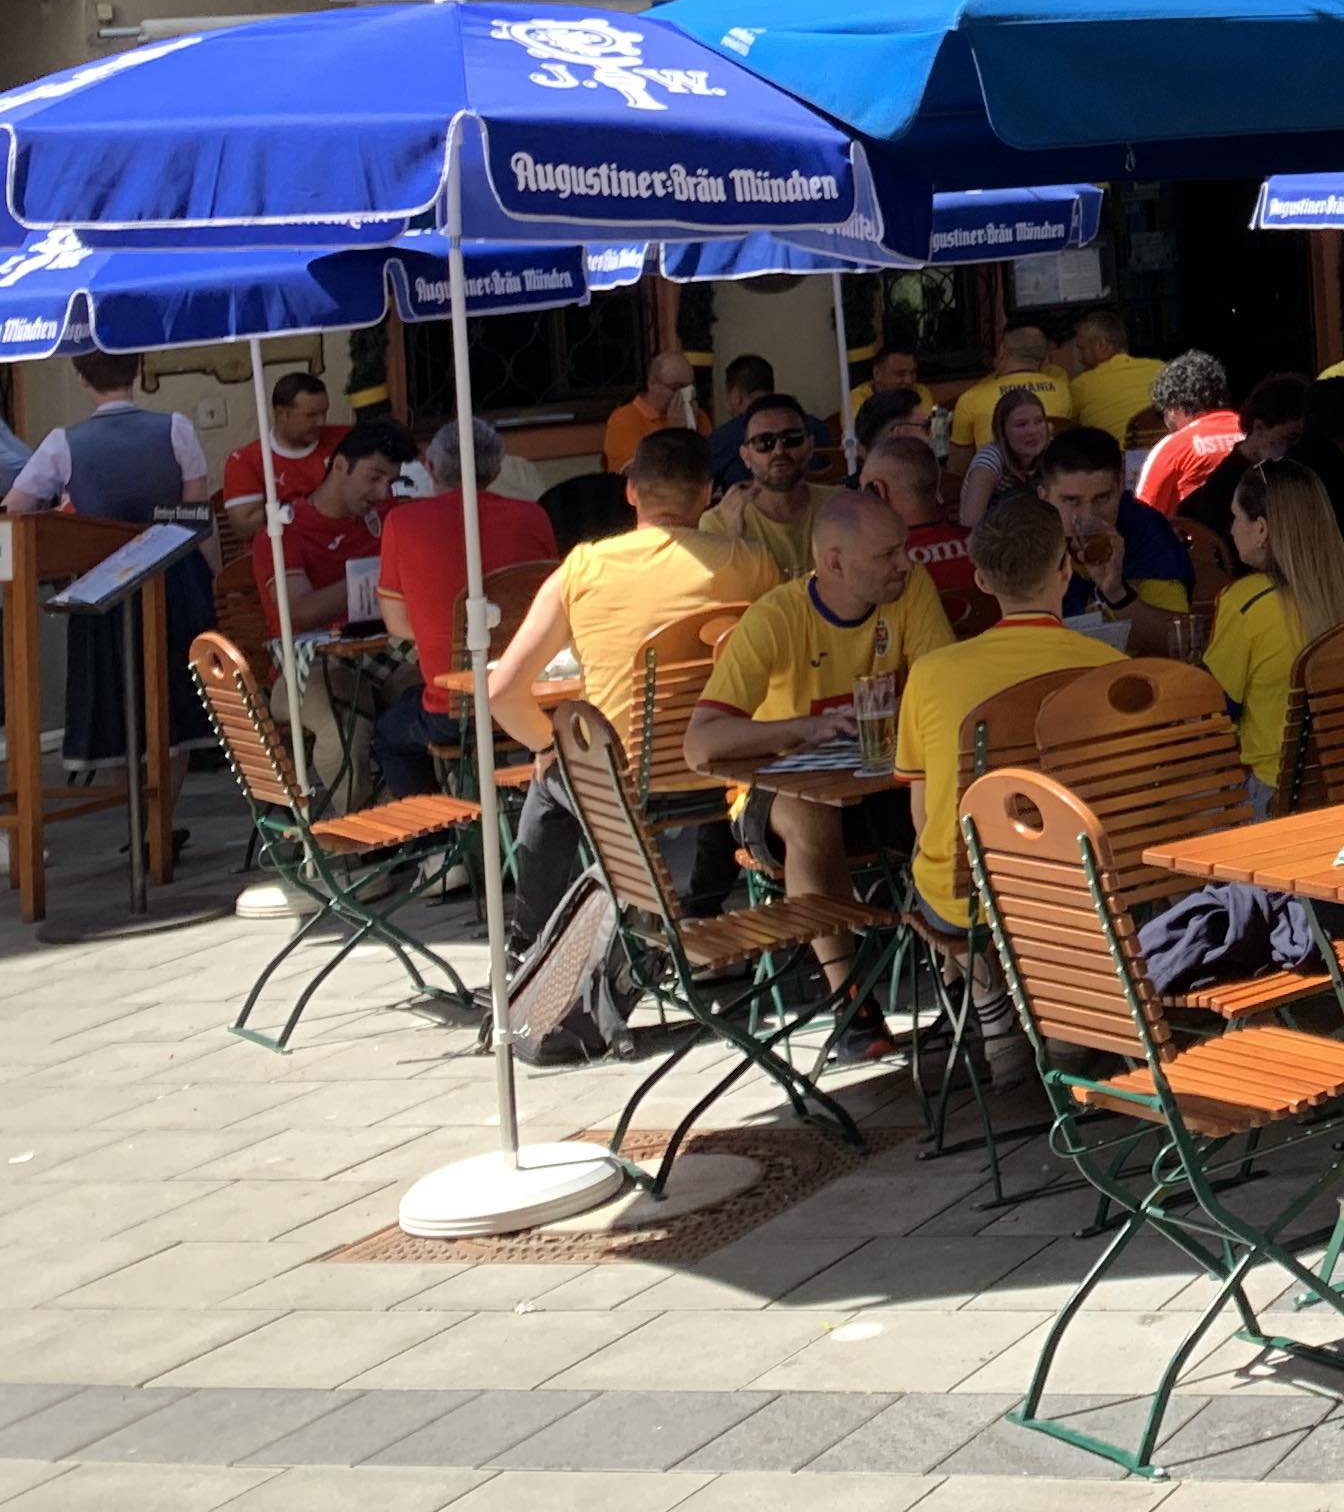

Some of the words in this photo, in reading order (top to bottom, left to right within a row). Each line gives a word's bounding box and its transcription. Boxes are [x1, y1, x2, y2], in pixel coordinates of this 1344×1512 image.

[510, 151, 727, 203] Augustiner-Bräu
[728, 168, 839, 203] München
[931, 220, 1013, 253] gustiner-Bräu
[1015, 221, 1065, 241] München
[415, 269, 521, 305] Auguiner-Bräu
[523, 268, 573, 290] München
[2, 318, 58, 343] München
